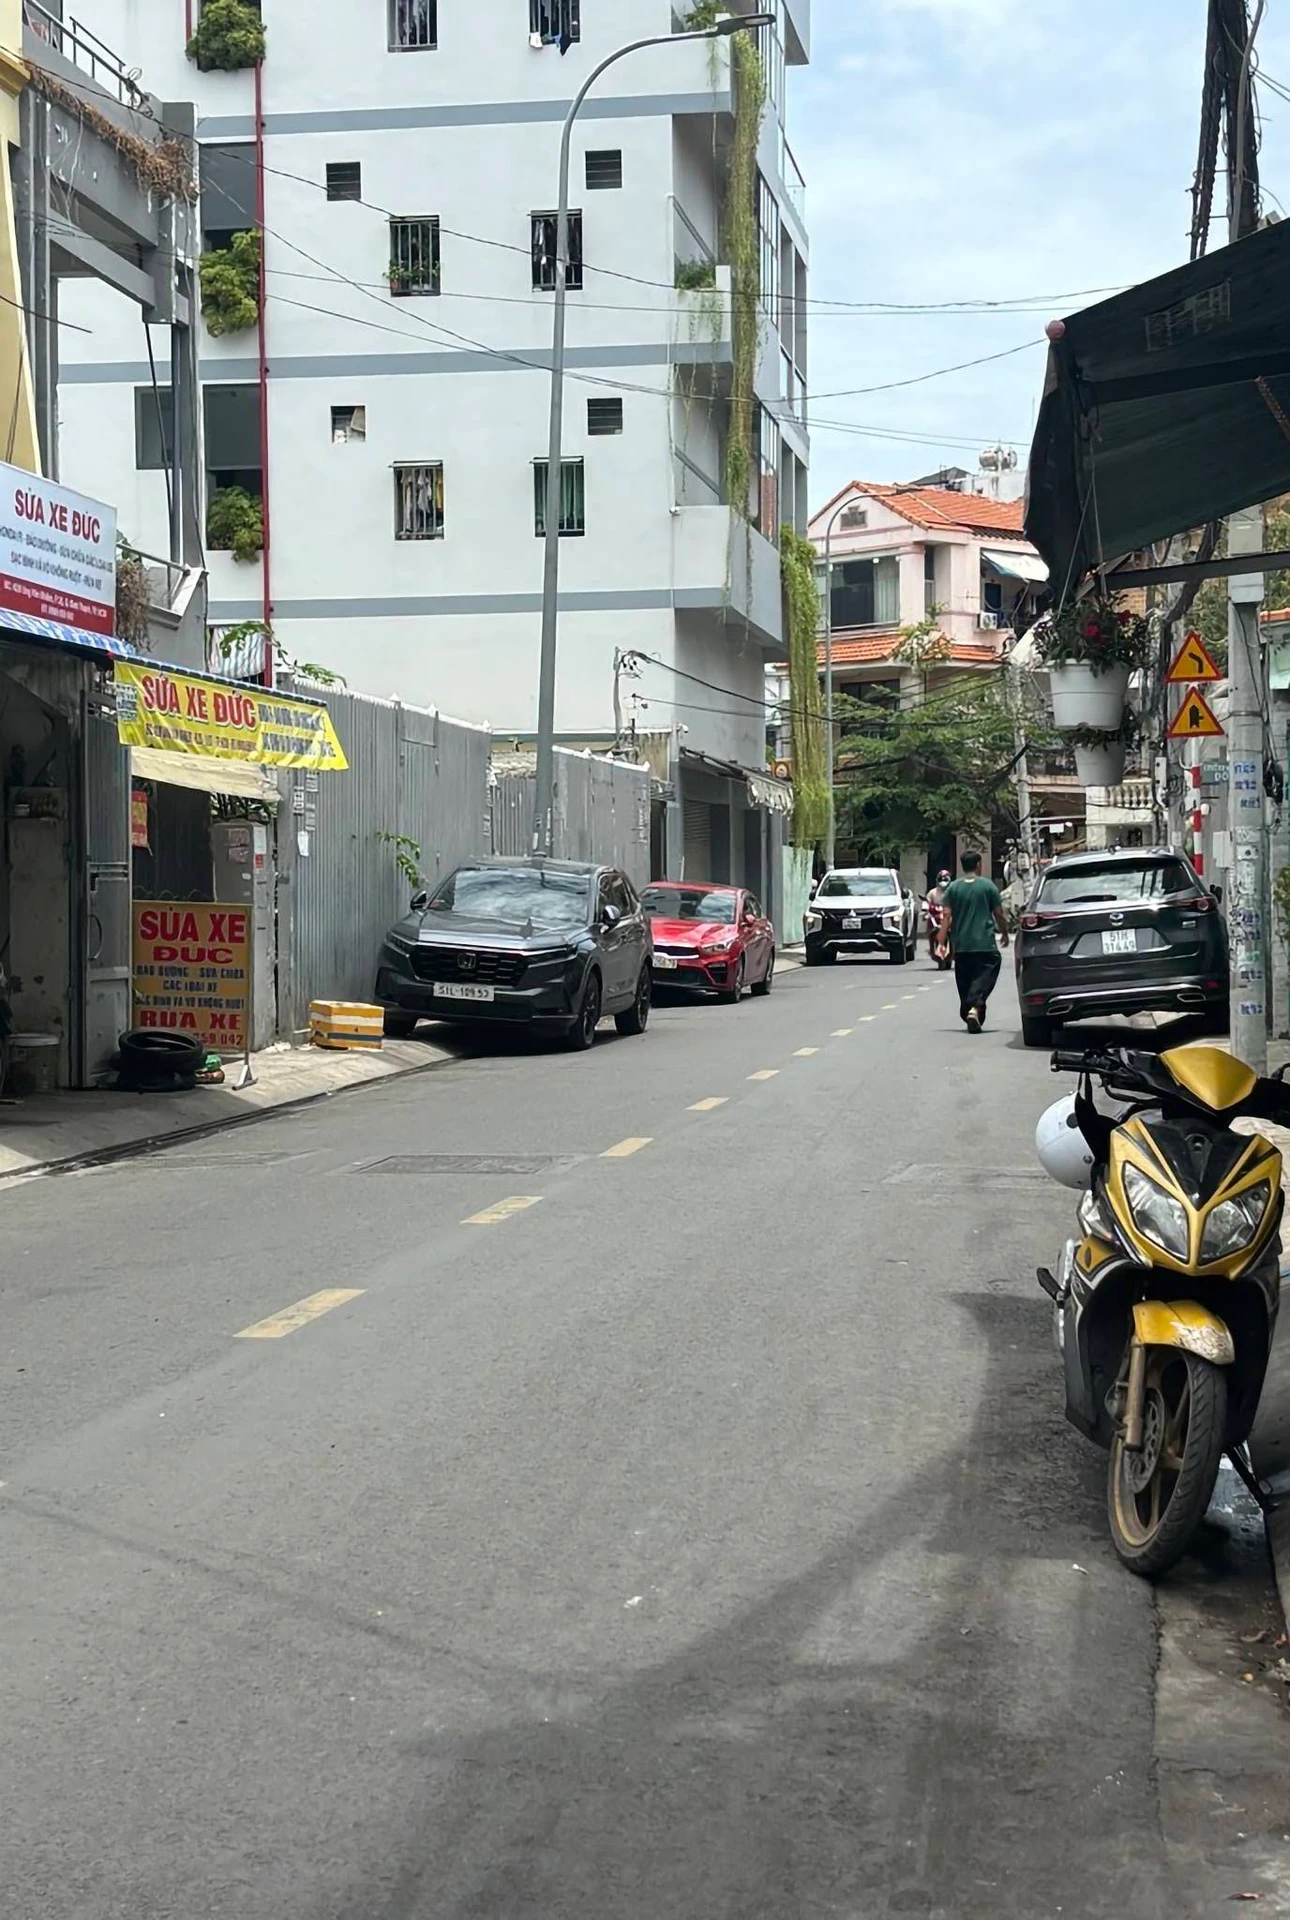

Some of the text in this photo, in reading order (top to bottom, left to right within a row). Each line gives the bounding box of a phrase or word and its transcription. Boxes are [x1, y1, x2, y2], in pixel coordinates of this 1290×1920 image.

[49, 500, 68, 532] XE
[72, 511, 101, 544] ĐỨC
[185, 685, 209, 721] XE
[213, 689, 257, 730] ĐỨC
[208, 913, 245, 944] XE
[210, 1013, 241, 1030] XE
